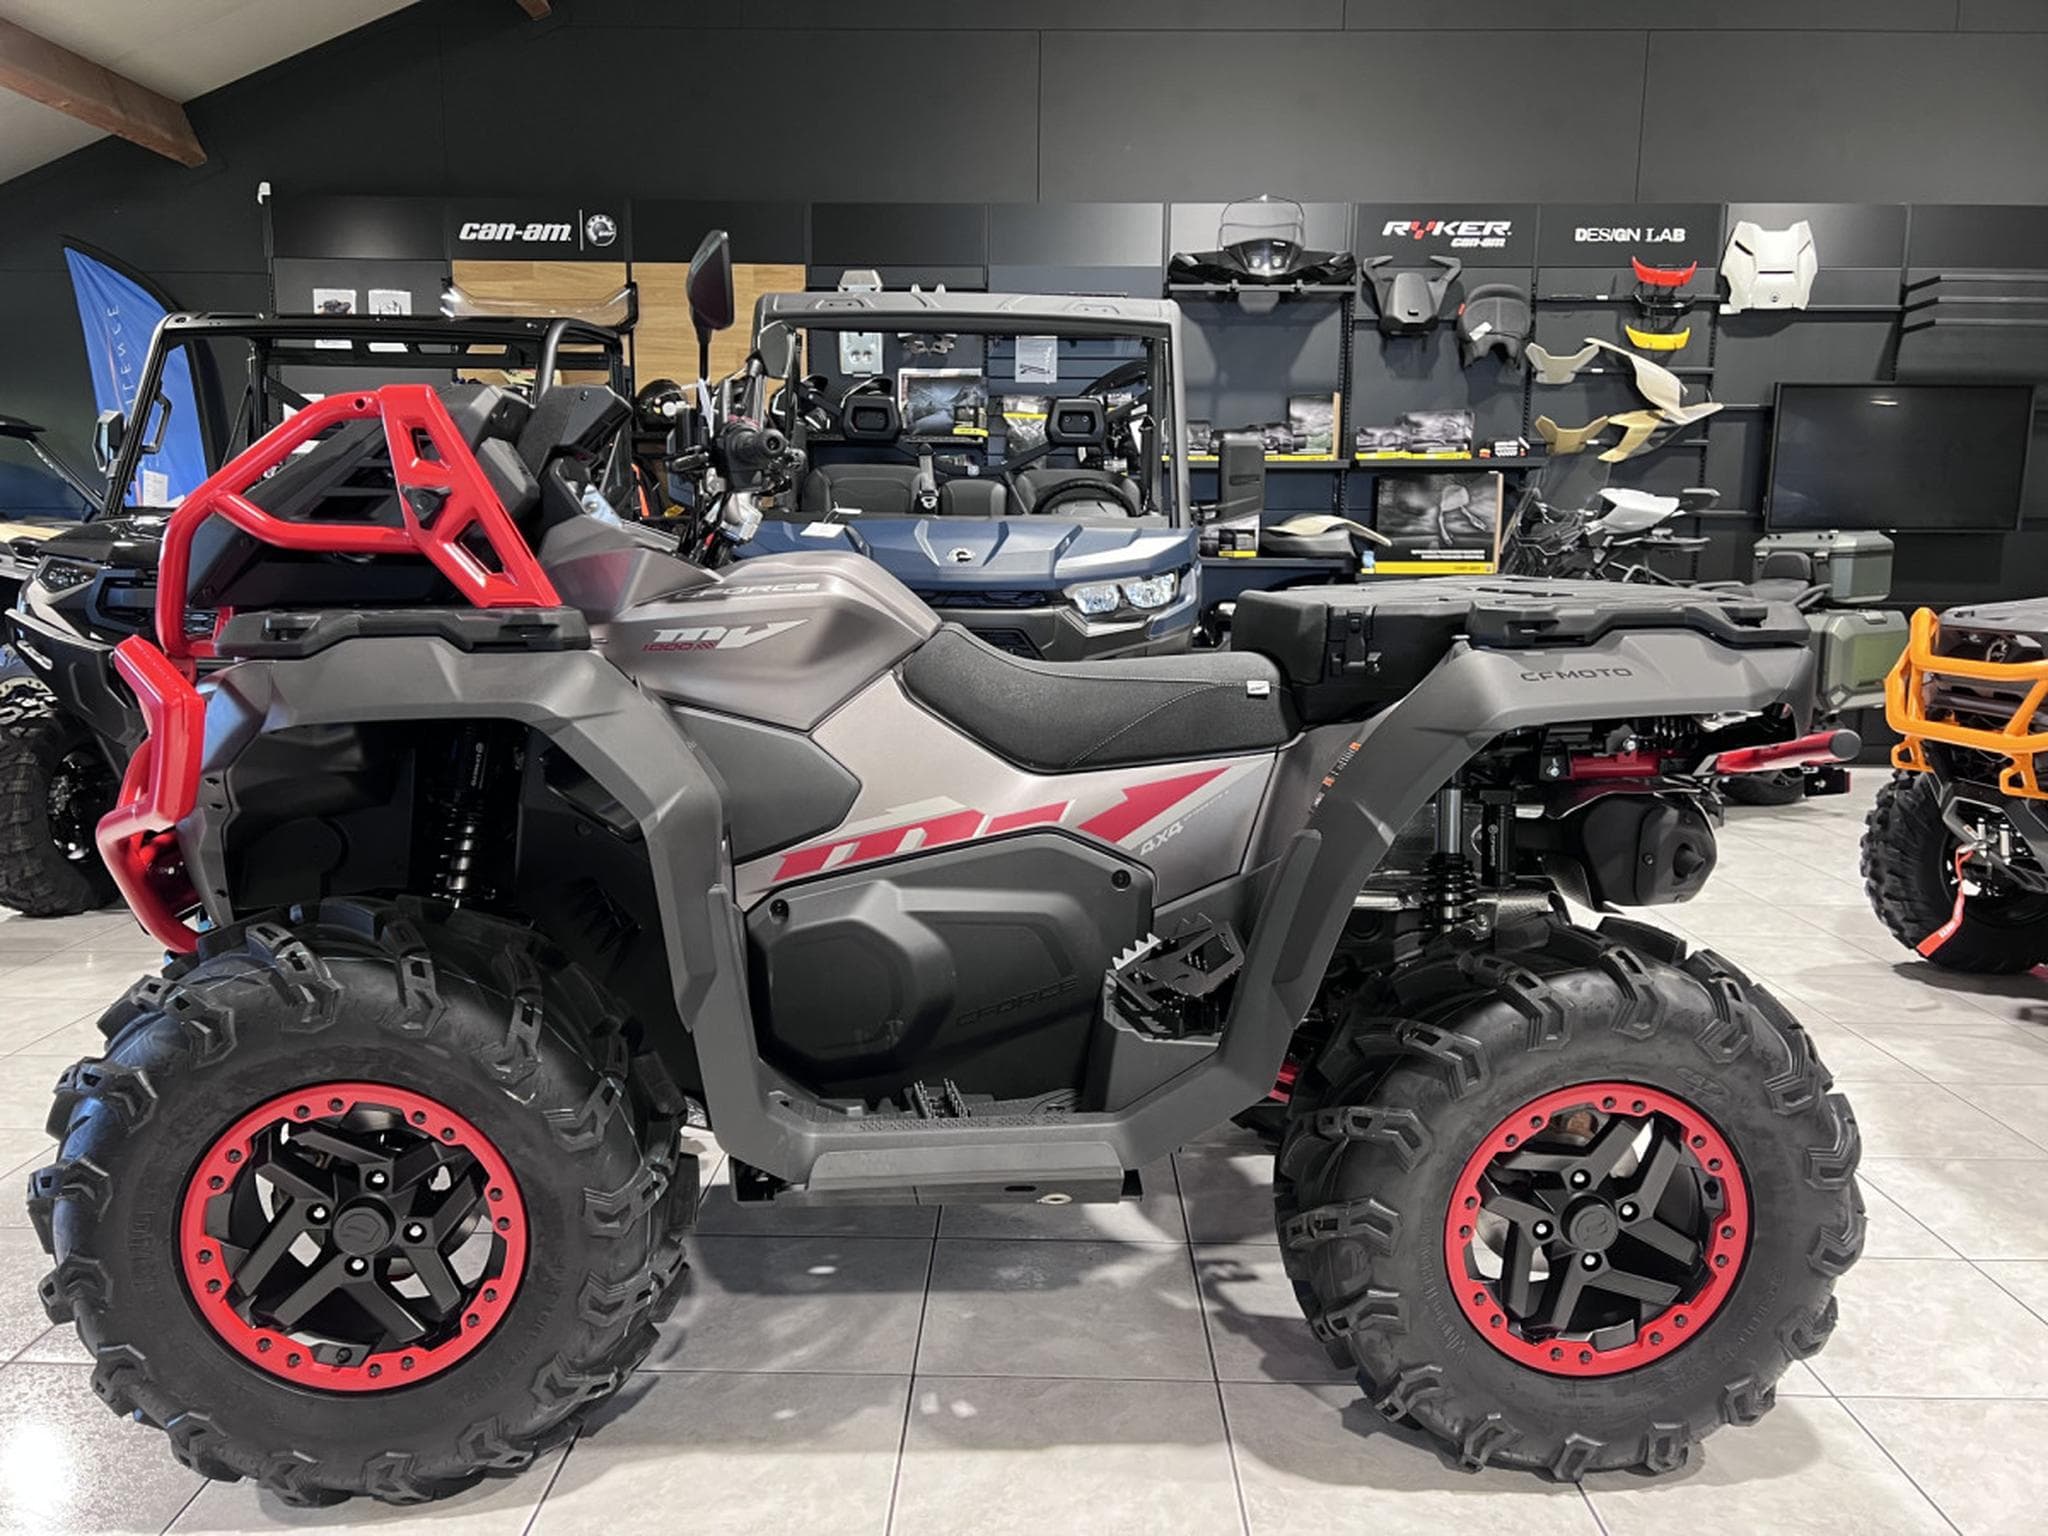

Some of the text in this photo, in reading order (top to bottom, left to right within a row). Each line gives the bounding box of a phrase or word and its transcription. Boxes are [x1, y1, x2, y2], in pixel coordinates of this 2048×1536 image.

[459, 222, 572, 242] can-am
[1382, 220, 1512, 240] RYKER
[1574, 227, 1686, 242] DESIGN LAB
[1520, 668, 1632, 682] CFMOTO
